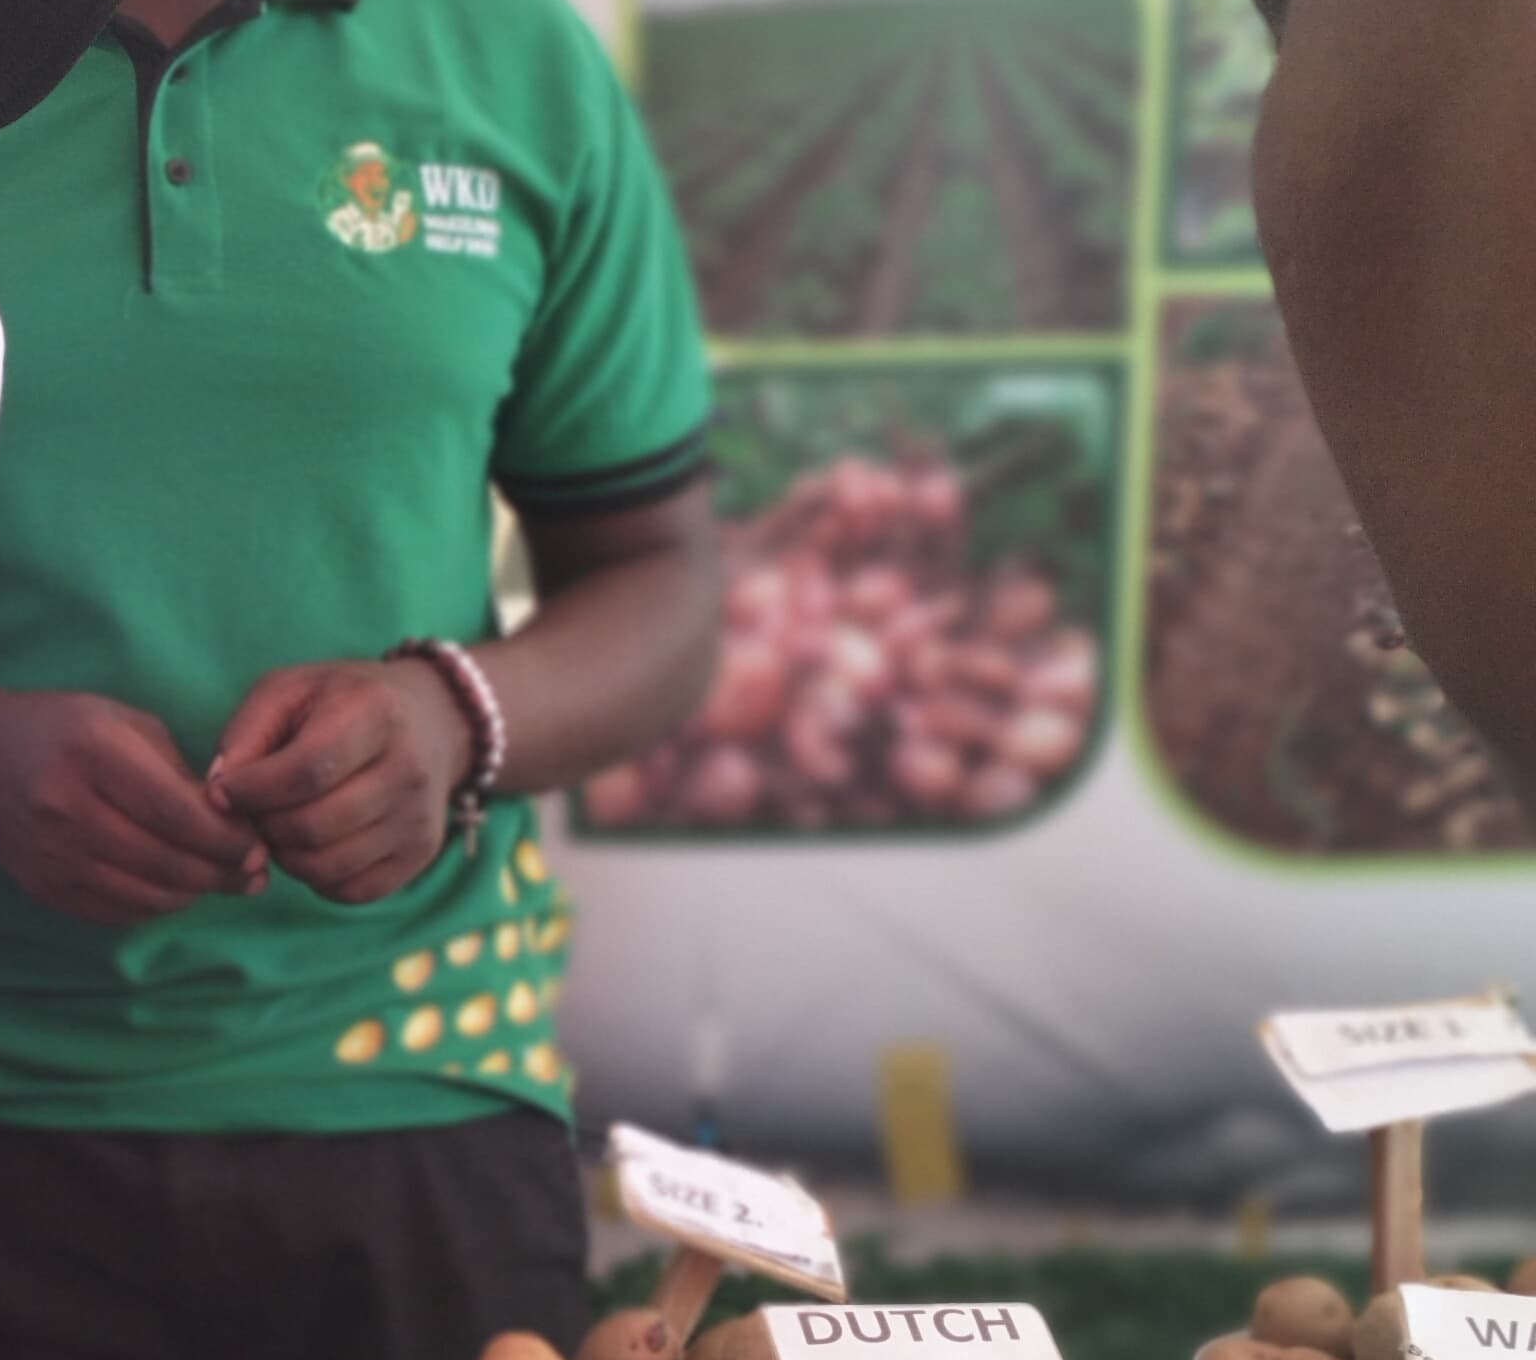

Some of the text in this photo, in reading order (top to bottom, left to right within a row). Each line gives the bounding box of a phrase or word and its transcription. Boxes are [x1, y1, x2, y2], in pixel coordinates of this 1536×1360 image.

[419, 163, 501, 212] WKD
[648, 1170, 721, 1221] SIZE
[797, 1307, 1021, 1346] DUTCH
